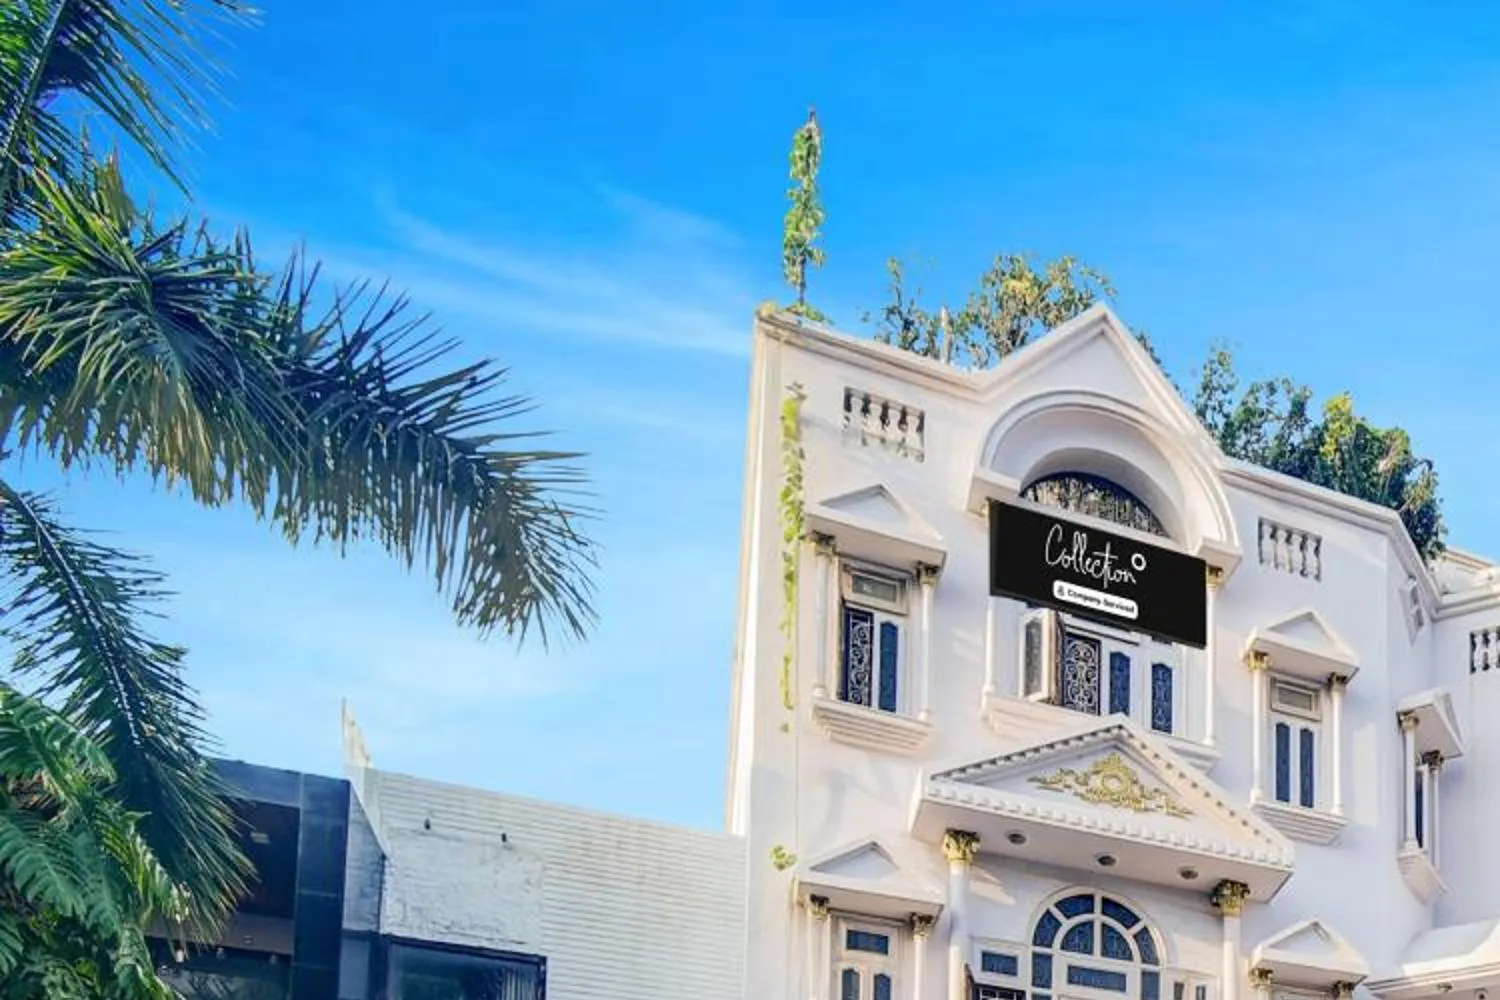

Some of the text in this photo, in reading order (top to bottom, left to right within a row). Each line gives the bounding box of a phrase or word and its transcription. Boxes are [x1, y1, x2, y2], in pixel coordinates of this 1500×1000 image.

[1045, 524, 1136, 588] Collection
[1067, 588, 1135, 613] Company Serviced
